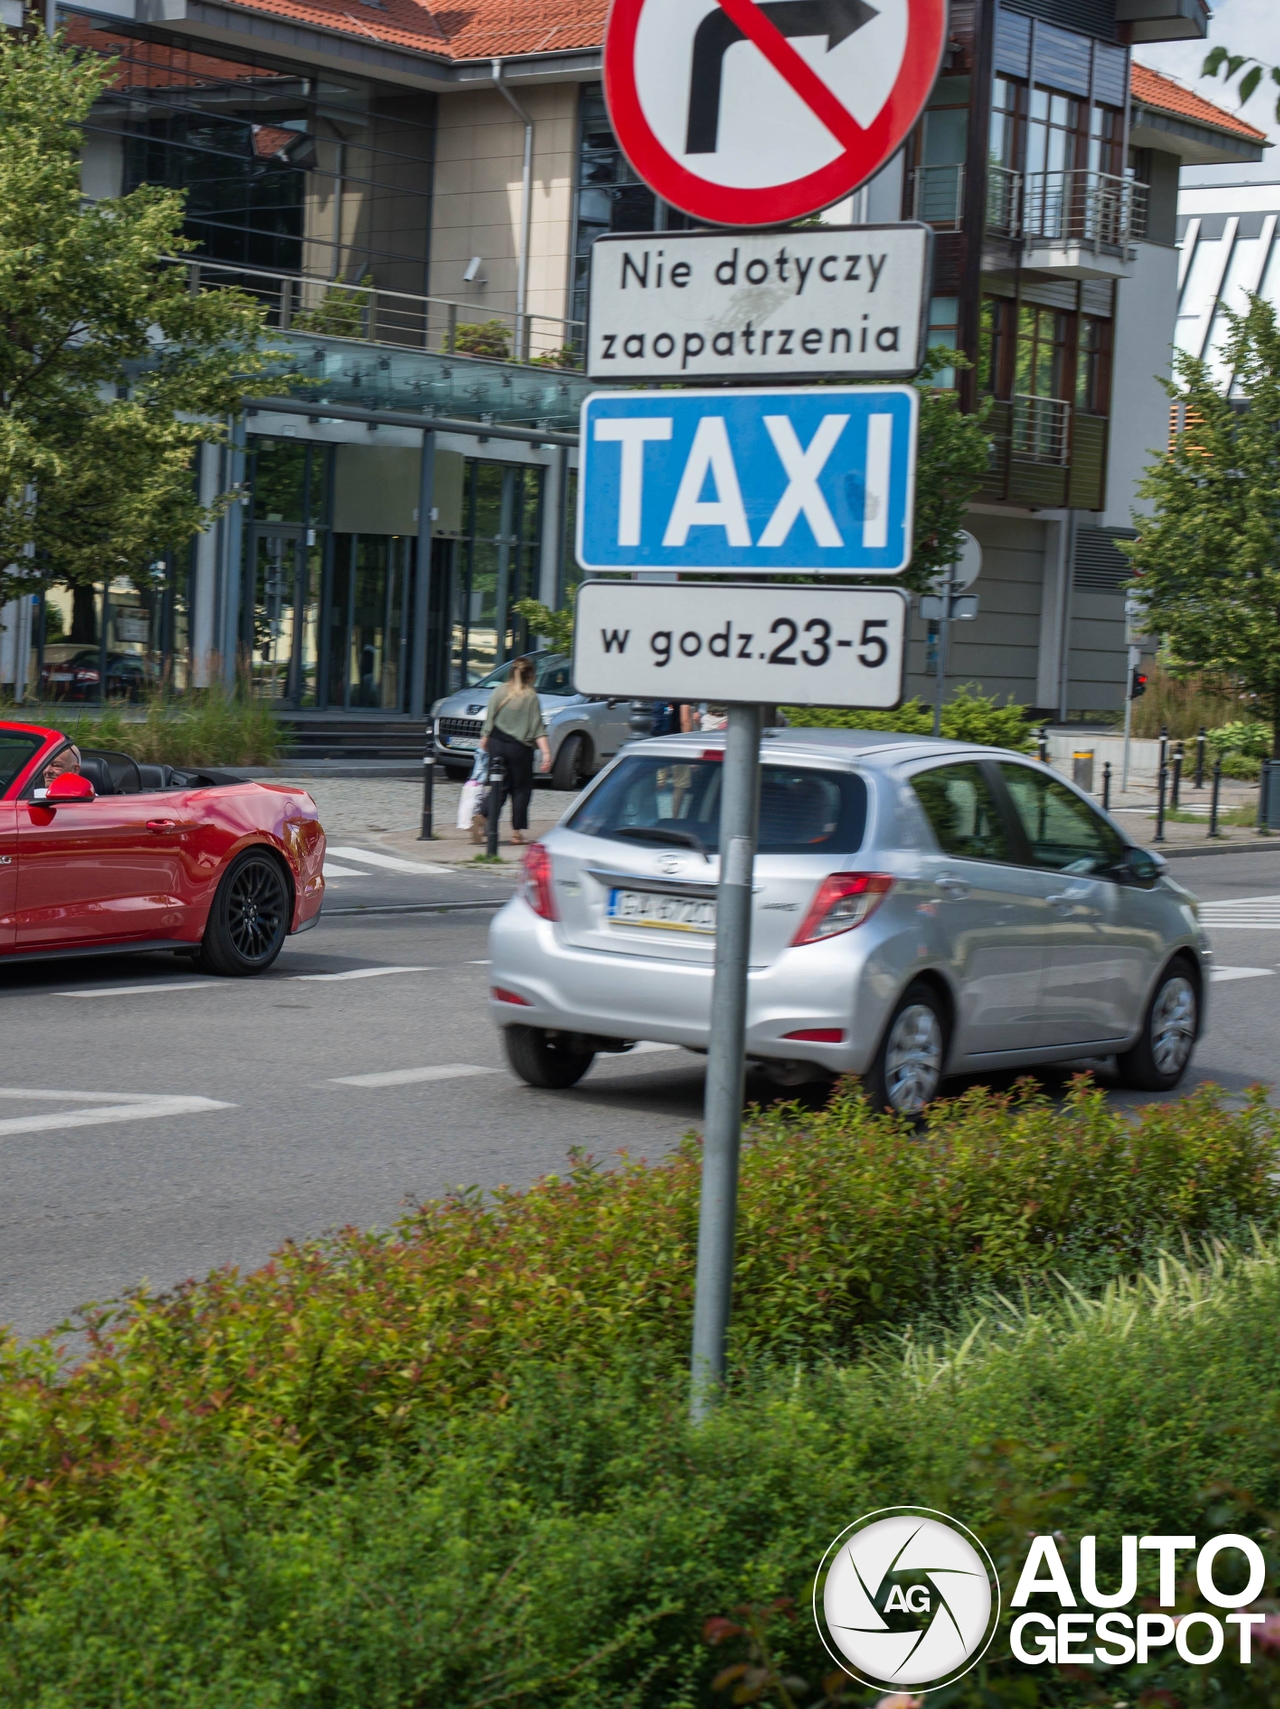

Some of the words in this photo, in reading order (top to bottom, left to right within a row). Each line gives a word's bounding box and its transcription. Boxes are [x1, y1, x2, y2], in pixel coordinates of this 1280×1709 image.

[621, 251, 692, 289] Nie
[715, 246, 888, 295] dotyczy
[601, 313, 900, 369] zaopatrzenia
[593, 413, 893, 548] TAXI
[601, 628, 630, 654] w
